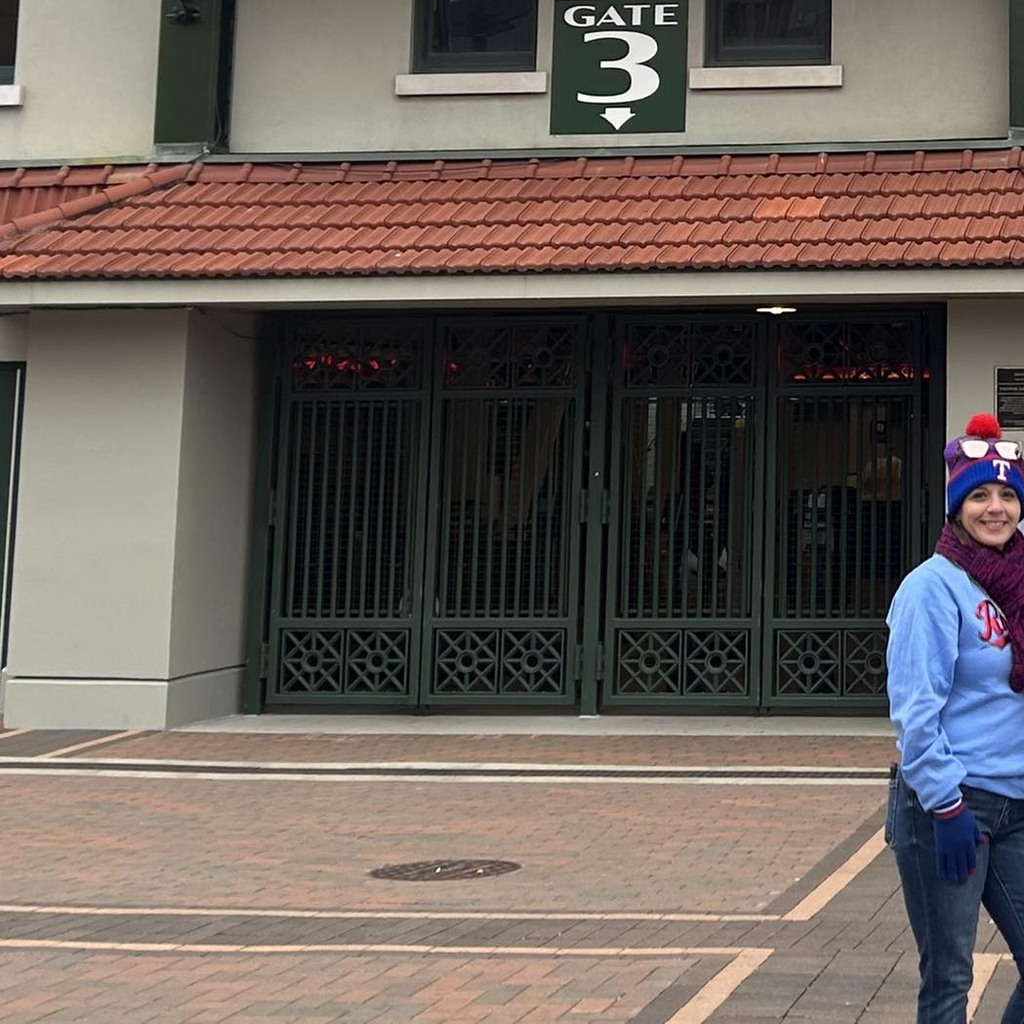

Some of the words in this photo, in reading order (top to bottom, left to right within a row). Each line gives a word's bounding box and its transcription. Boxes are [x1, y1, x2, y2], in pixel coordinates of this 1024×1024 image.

[563, 4, 679, 27] GATE
[577, 30, 660, 104] 3
[992, 459, 1011, 481] T
